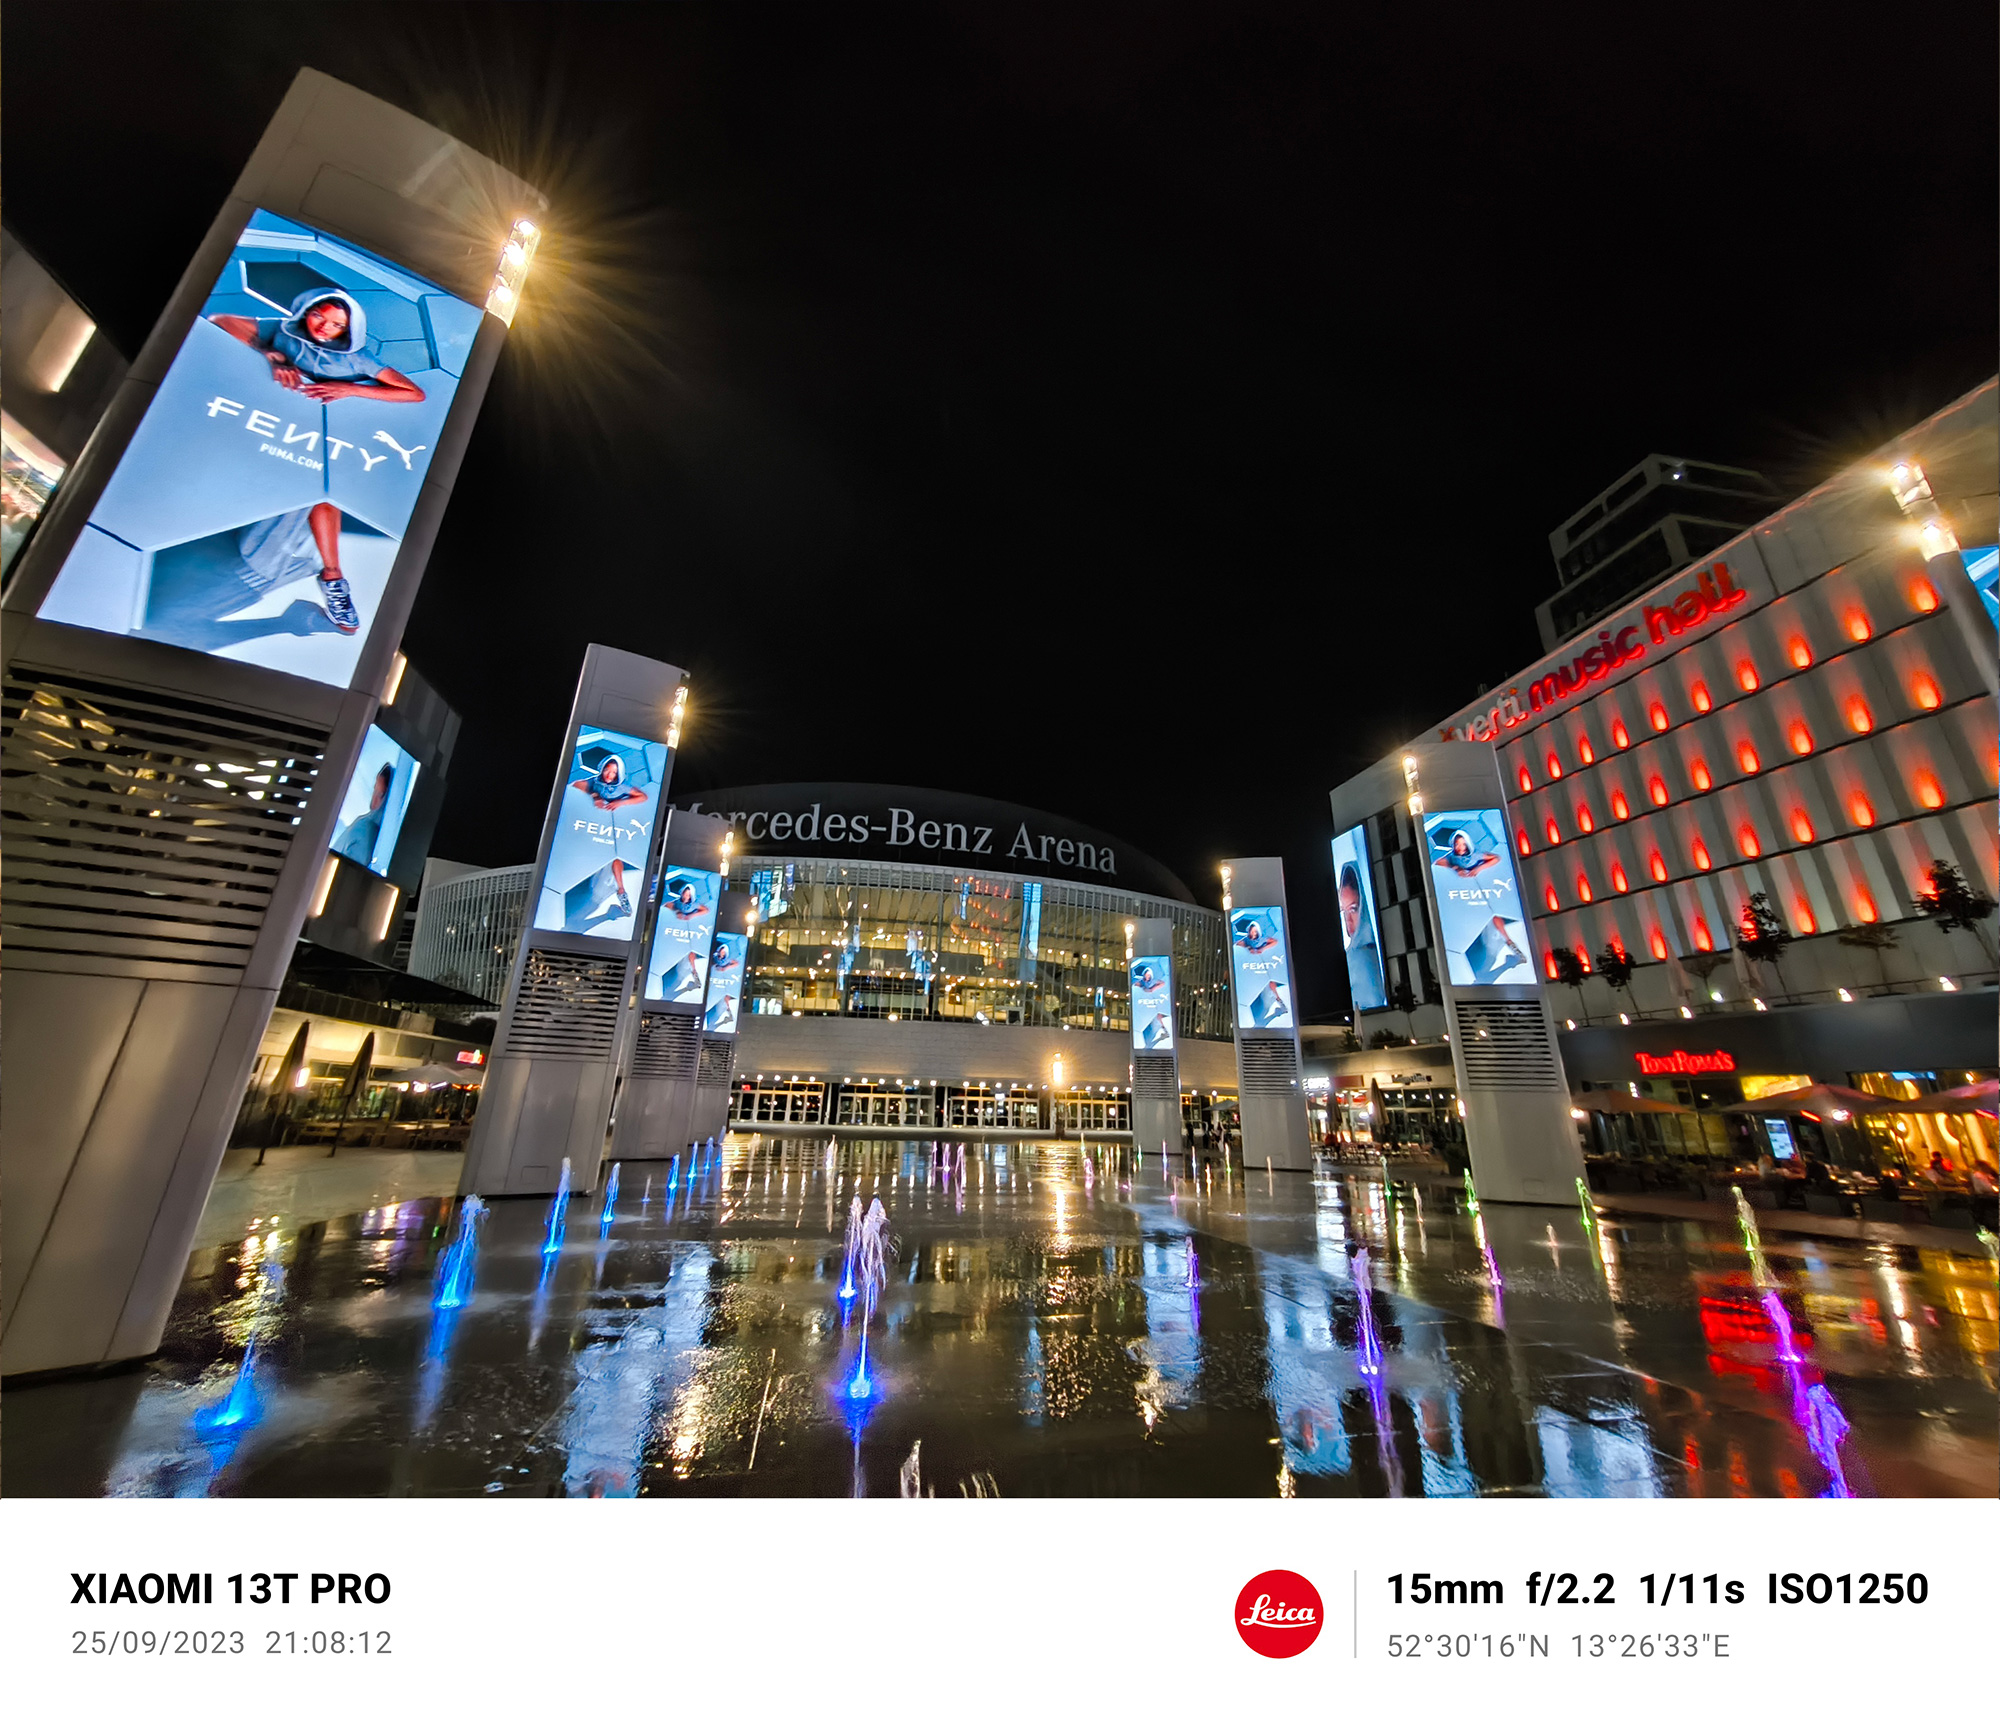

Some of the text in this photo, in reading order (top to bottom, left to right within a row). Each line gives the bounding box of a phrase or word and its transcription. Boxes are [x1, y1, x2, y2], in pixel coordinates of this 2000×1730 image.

[259, 442, 325, 472] PUMA.COM
[1455, 561, 1747, 743] verti music hall
[667, 802, 1118, 876] rcedes-Benz Arena
